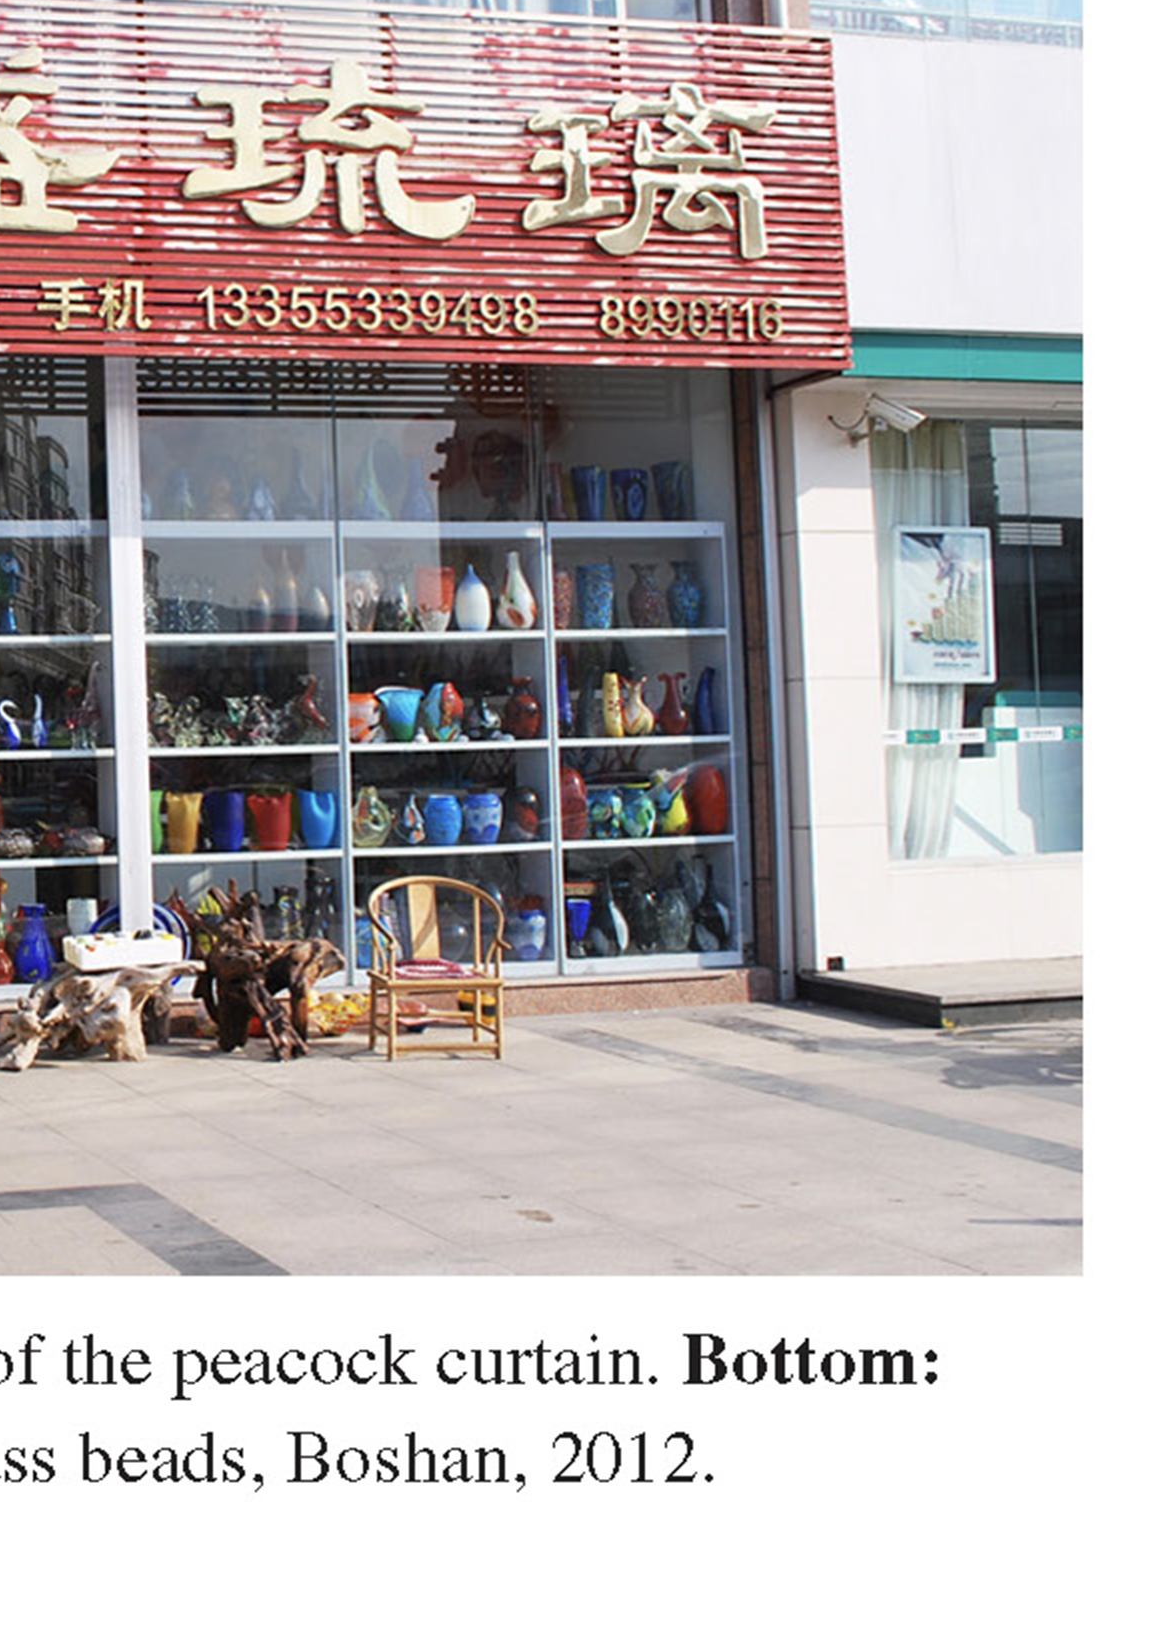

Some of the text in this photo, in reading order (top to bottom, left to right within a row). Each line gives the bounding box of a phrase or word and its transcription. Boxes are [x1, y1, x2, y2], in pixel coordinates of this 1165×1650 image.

[37, 278, 784, 340] 手机 13355339498 8990116
